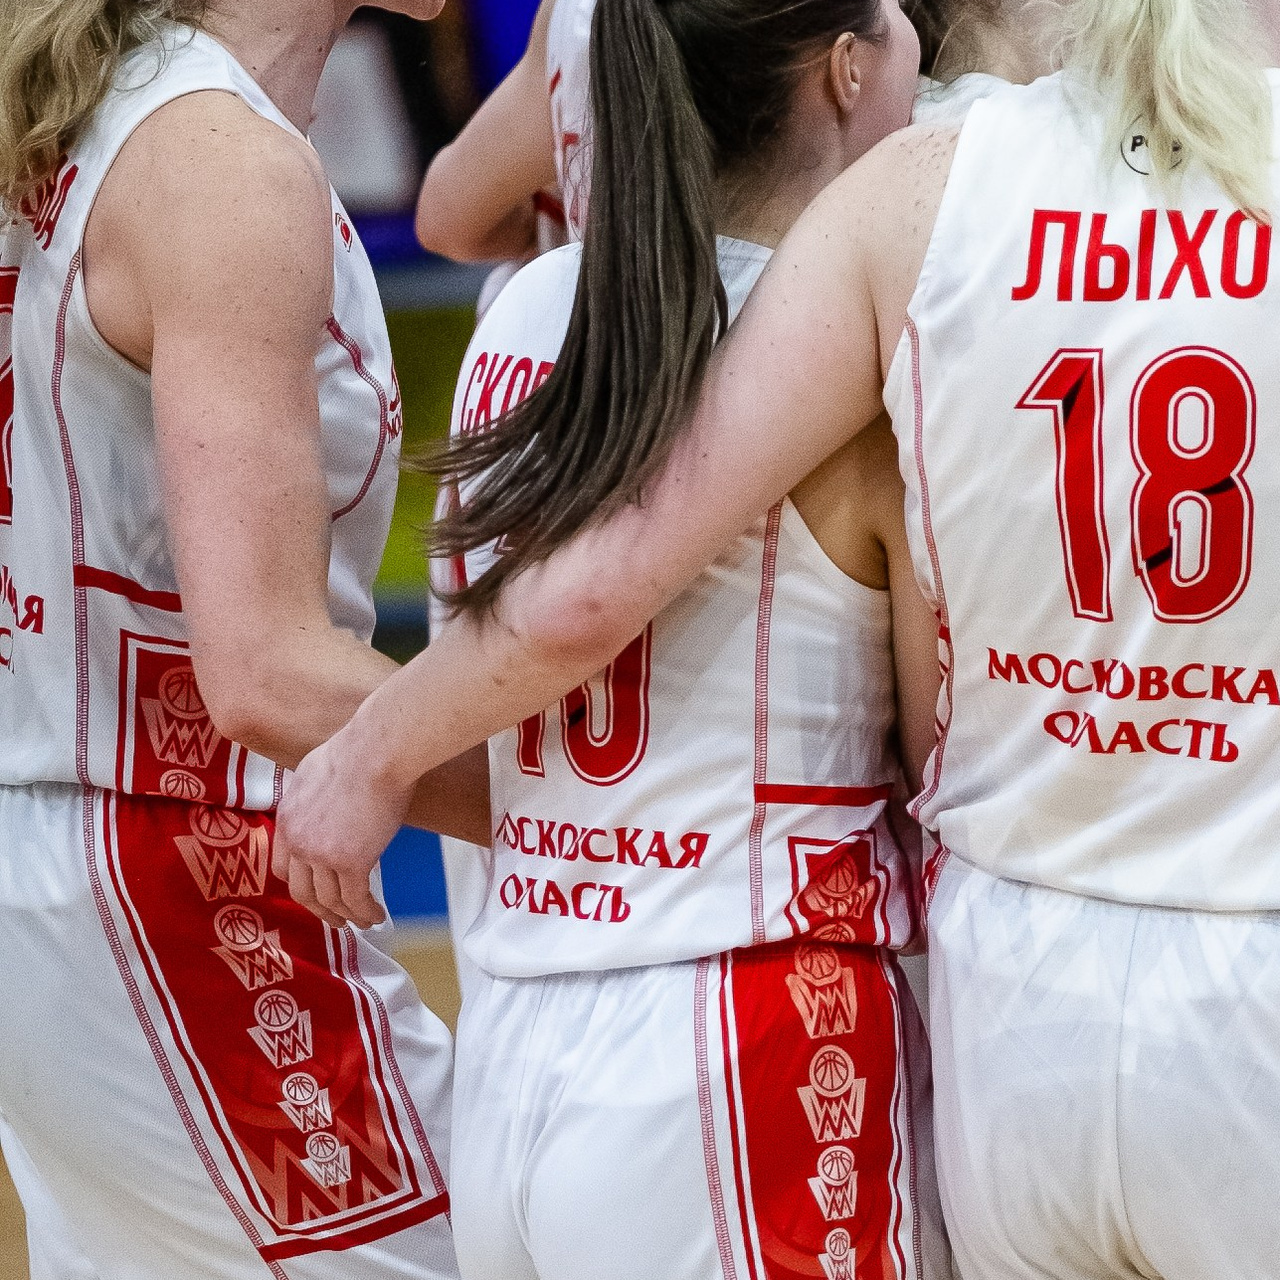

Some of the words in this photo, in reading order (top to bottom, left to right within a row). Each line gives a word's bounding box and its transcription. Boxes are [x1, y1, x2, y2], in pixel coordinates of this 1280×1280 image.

[1011, 208, 1272, 302] ЛЫХО
[1014, 346, 1257, 624] 18
[1042, 709, 1240, 763] ОЛАСТЬ
[499, 872, 632, 923] ОЛАСТЬ
